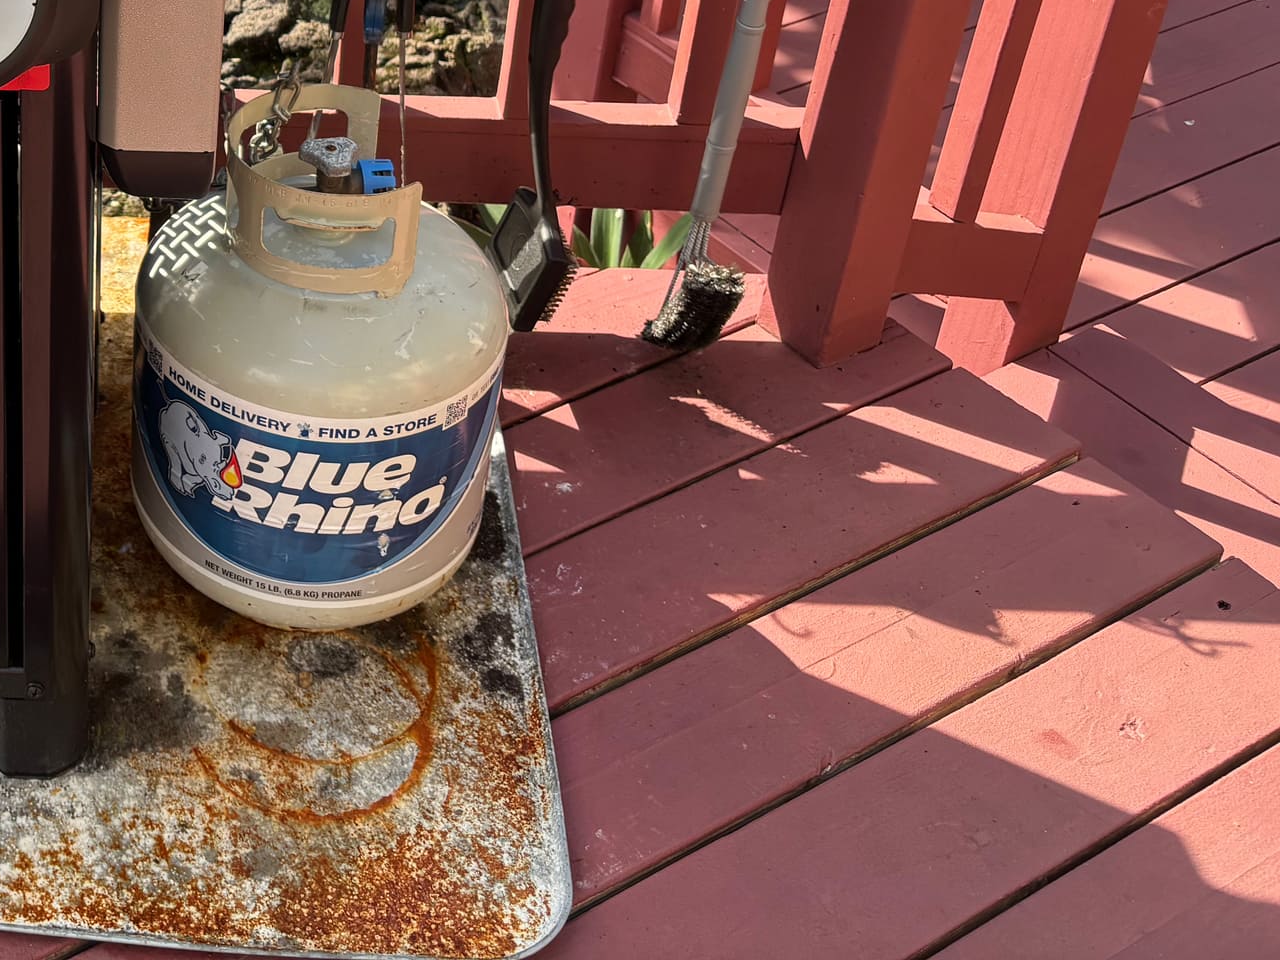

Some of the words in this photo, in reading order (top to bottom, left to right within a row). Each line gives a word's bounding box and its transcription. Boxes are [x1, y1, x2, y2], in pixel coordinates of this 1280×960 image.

[169, 366, 207, 402] HOME
[210, 396, 291, 433] DELIVERY
[318, 427, 361, 439] FIND
[365, 427, 378, 438] A
[383, 413, 438, 436] STORE
[234, 438, 417, 495] Blue
[210, 483, 446, 535] Rhino
[204, 559, 220, 572] NET
[221, 566, 254, 586] WEIGHT
[255, 581, 266, 590] 15
[268, 584, 282, 594] LB.
[284, 587, 301, 597] (6.8
[303, 590, 319, 599] KG)
[321, 589, 363, 600] PROPANE
